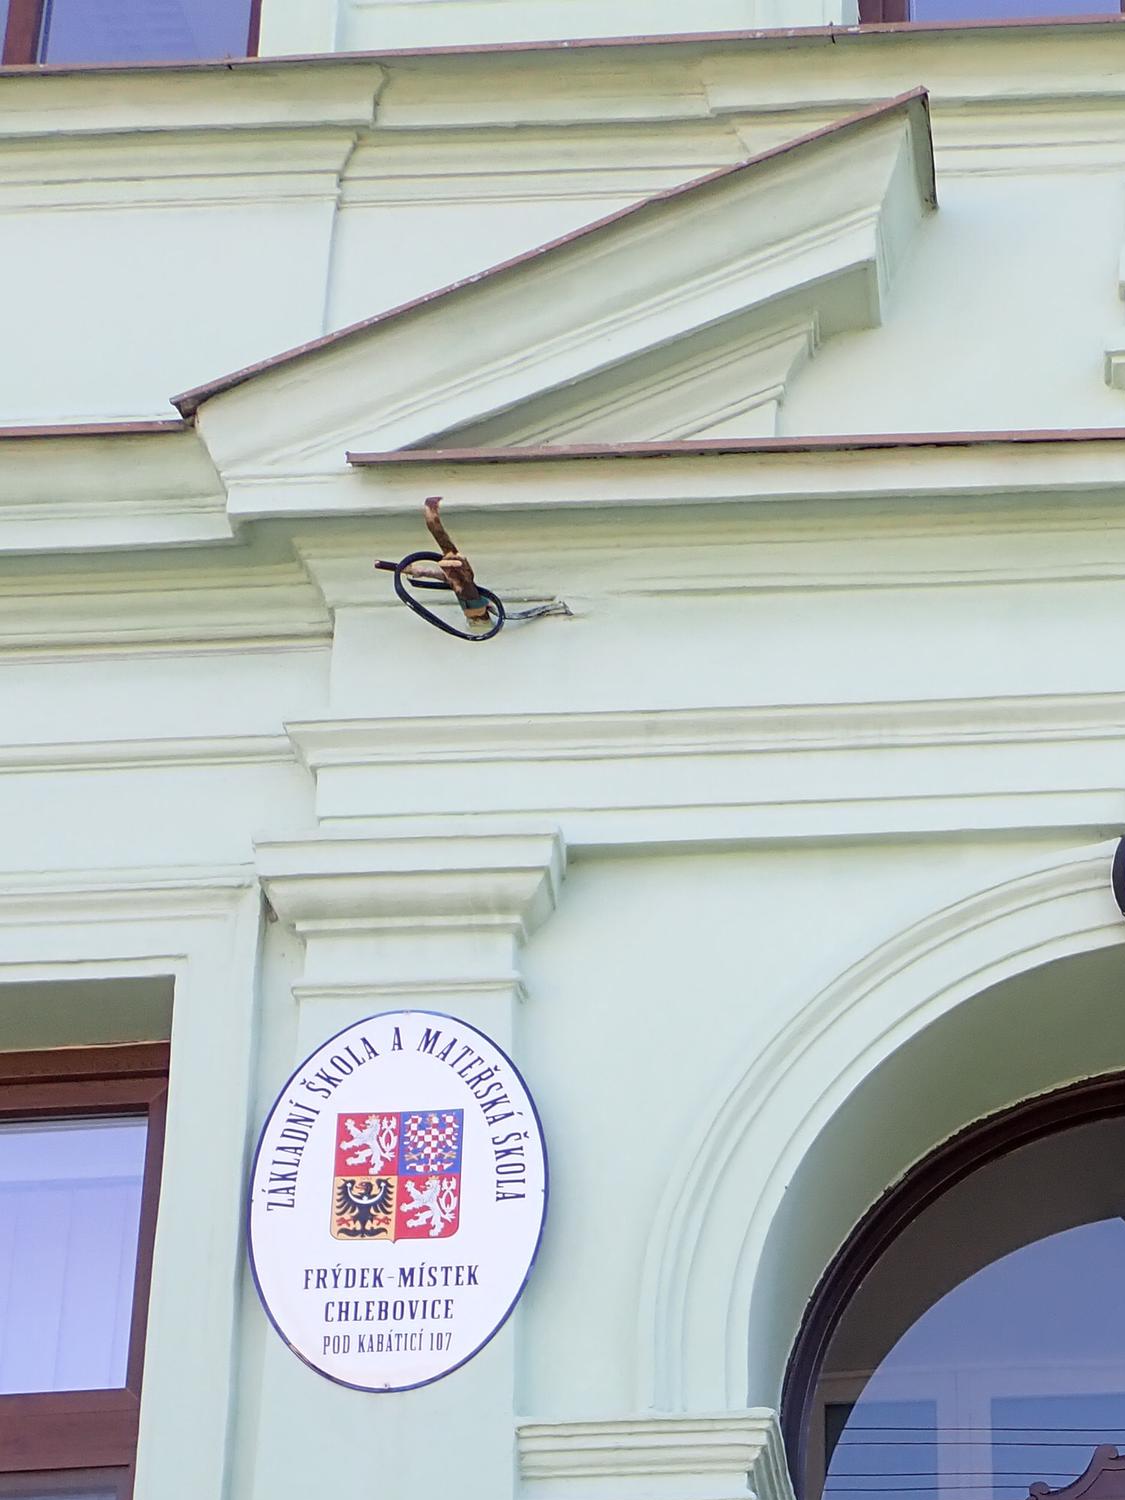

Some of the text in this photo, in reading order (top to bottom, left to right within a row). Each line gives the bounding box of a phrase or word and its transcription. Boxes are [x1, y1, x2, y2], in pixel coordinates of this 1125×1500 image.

[261, 1027, 527, 1211] ZÁKLADNÍ ŠKOLA A MATEŘSKÁ ŠKOLA
[324, 1299, 455, 1322] CHLEBOVICE
[322, 1329, 453, 1355] POD KABÁTICÍ 107
